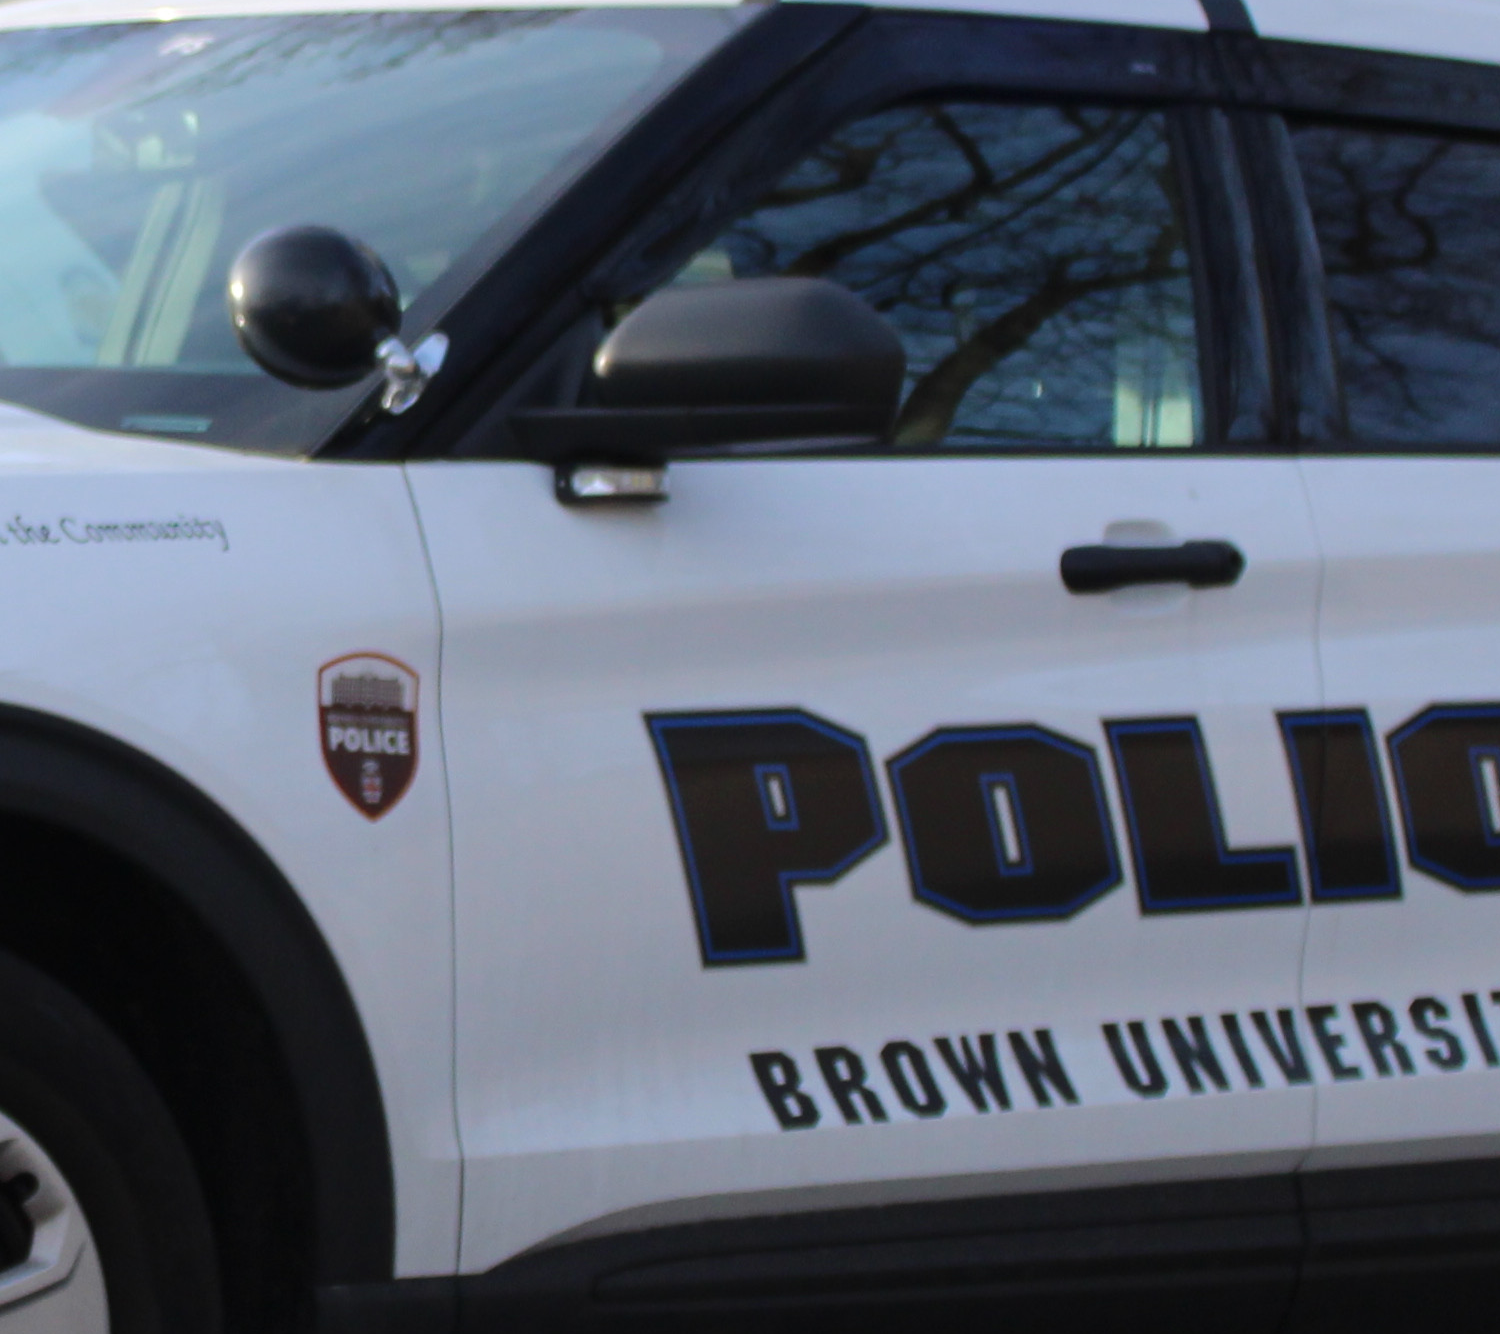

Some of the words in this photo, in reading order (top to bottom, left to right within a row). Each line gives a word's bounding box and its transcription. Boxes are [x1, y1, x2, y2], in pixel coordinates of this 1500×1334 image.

[5, 513, 60, 545] the
[59, 513, 229, 553] Community
[328, 725, 411, 756] POLICE
[749, 1029, 1079, 1132] BROWN
